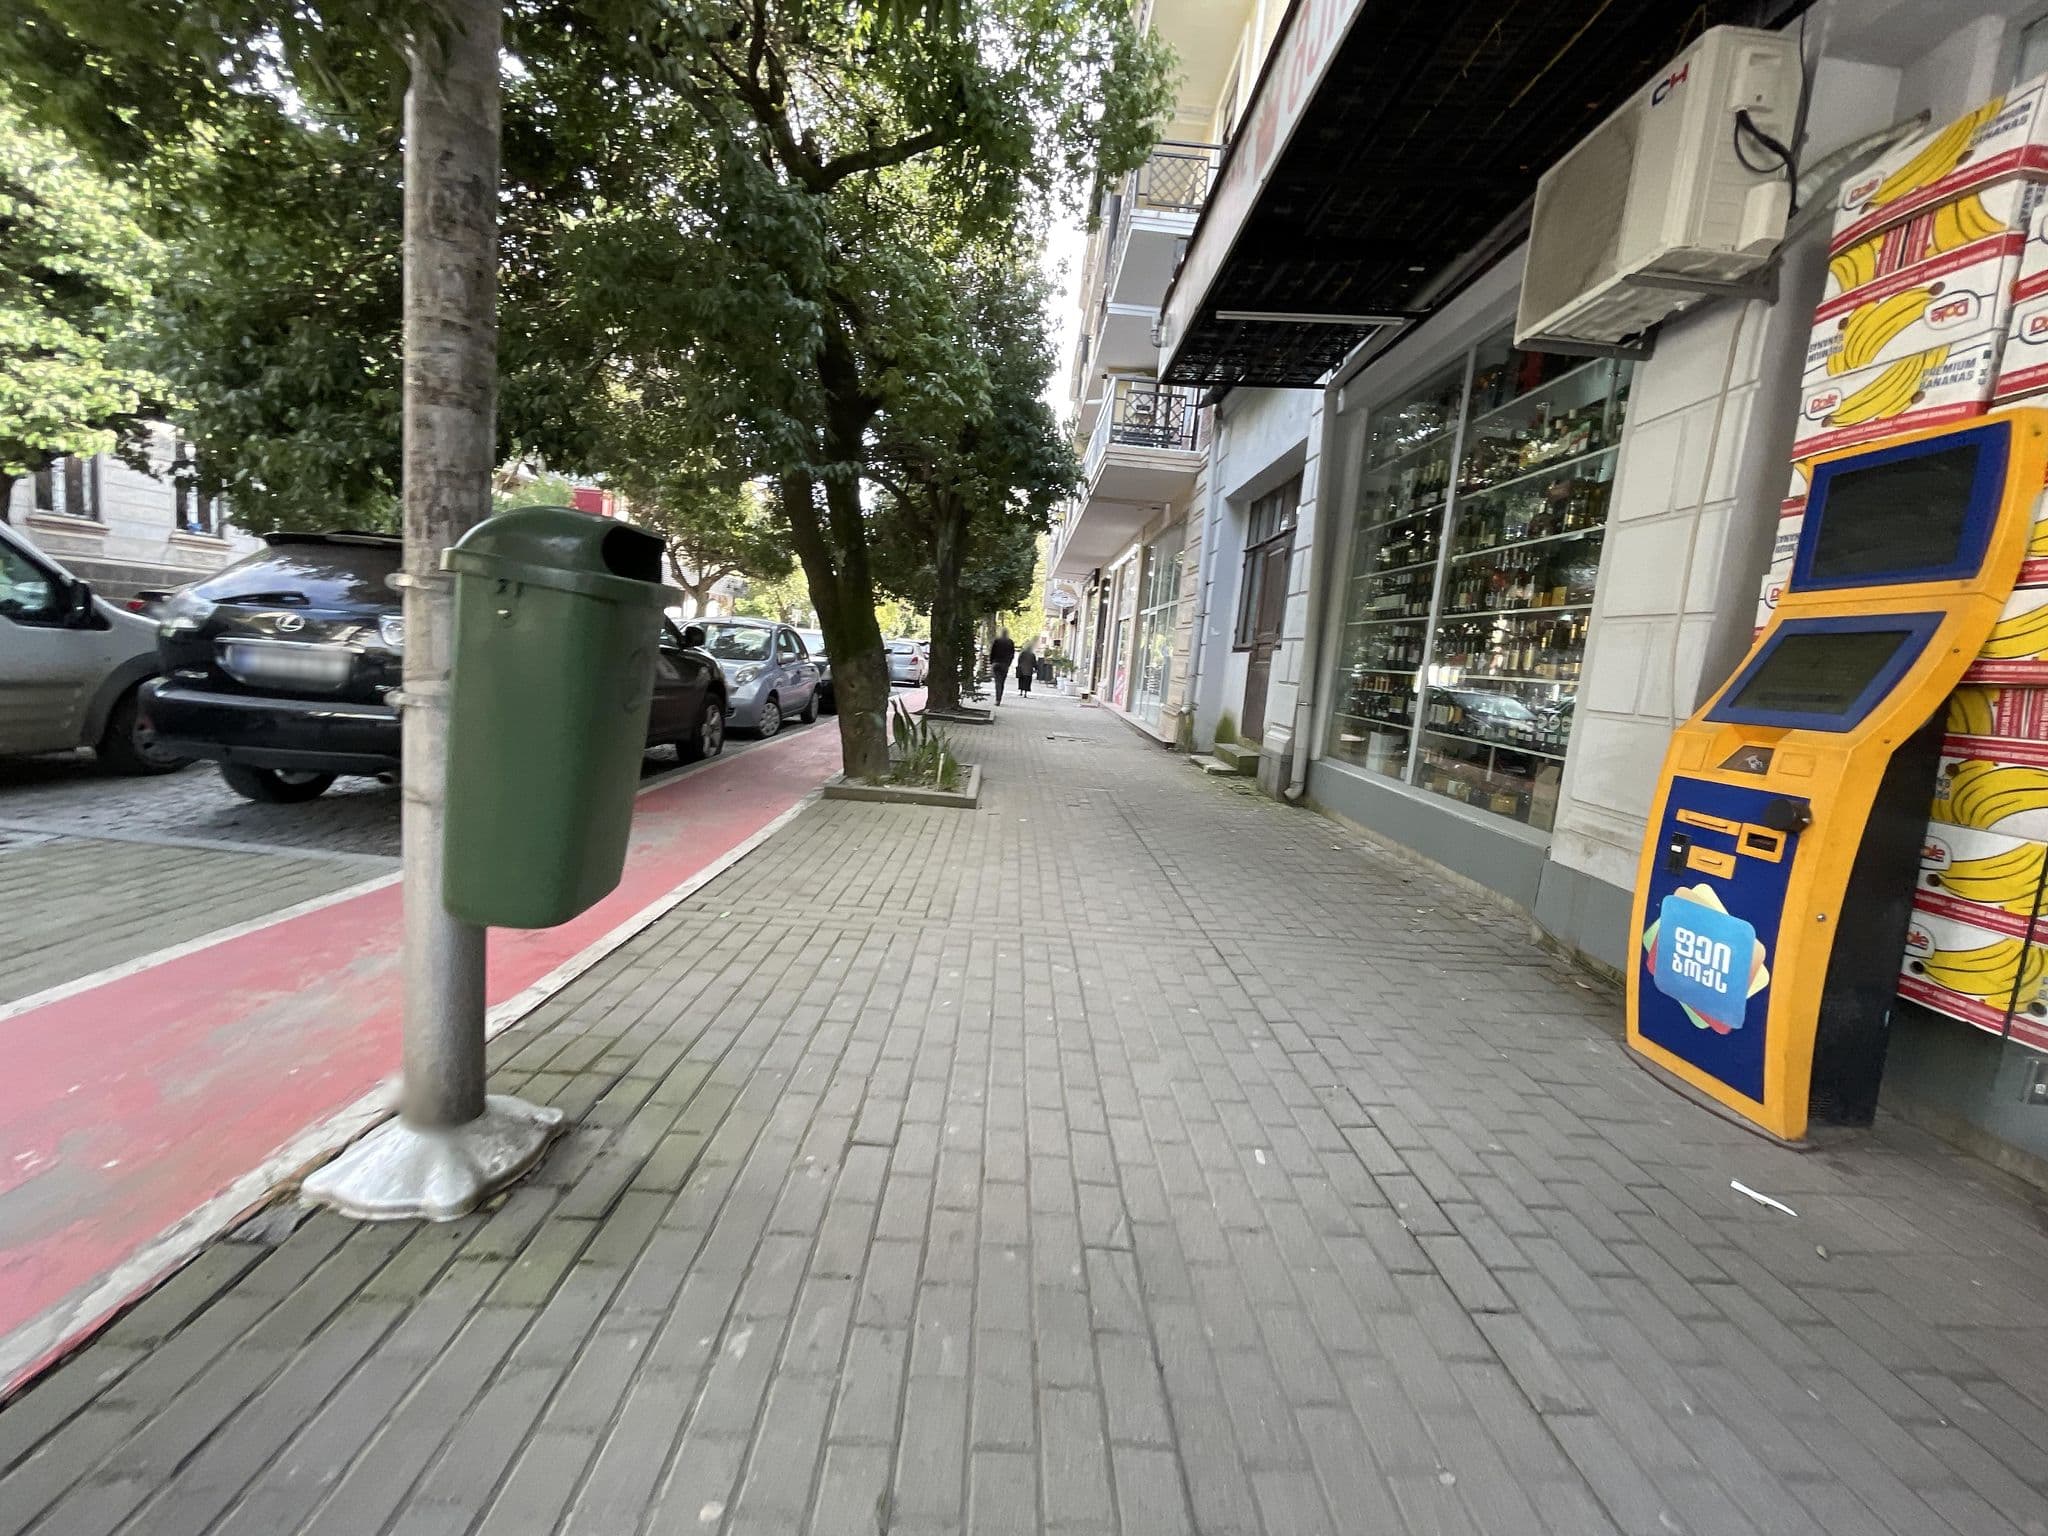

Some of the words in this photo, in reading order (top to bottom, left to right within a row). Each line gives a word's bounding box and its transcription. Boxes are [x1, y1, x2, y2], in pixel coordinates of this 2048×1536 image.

[1919, 371, 1974, 390] BANANAS
[1922, 357, 1976, 378] PREMIUM
[1675, 926, 1731, 974] ფეი
[1672, 952, 1727, 994] ბოქს
